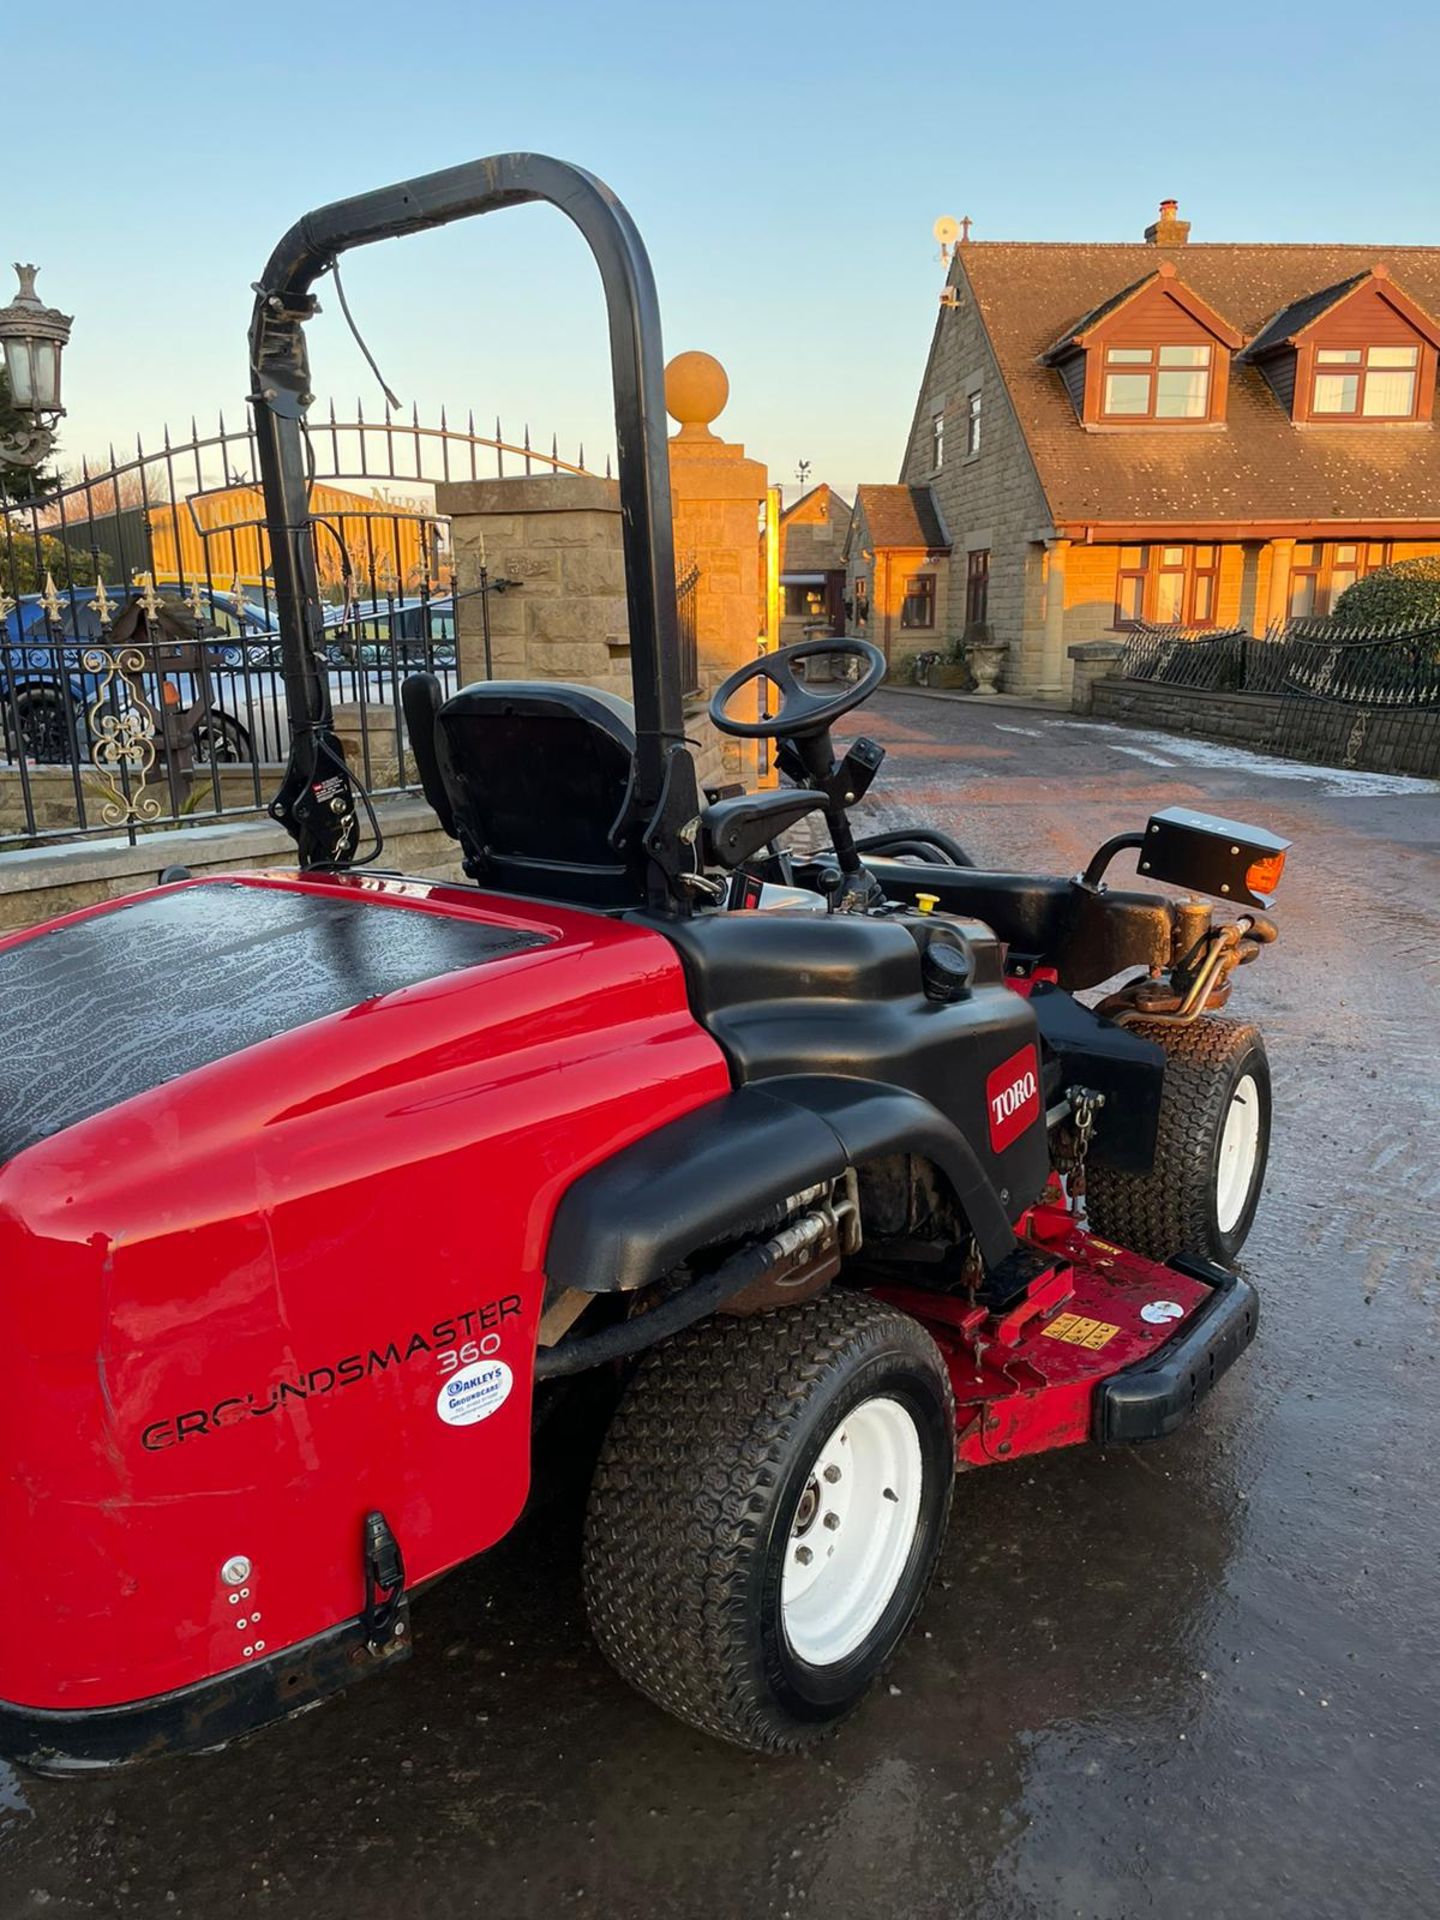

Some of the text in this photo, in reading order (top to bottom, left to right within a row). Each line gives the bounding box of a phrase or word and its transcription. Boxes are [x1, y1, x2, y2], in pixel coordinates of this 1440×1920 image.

[992, 1071, 1035, 1125] TORO
[142, 1294, 522, 1451] GROUNDSMASTER
[437, 1333, 501, 1375] 360
